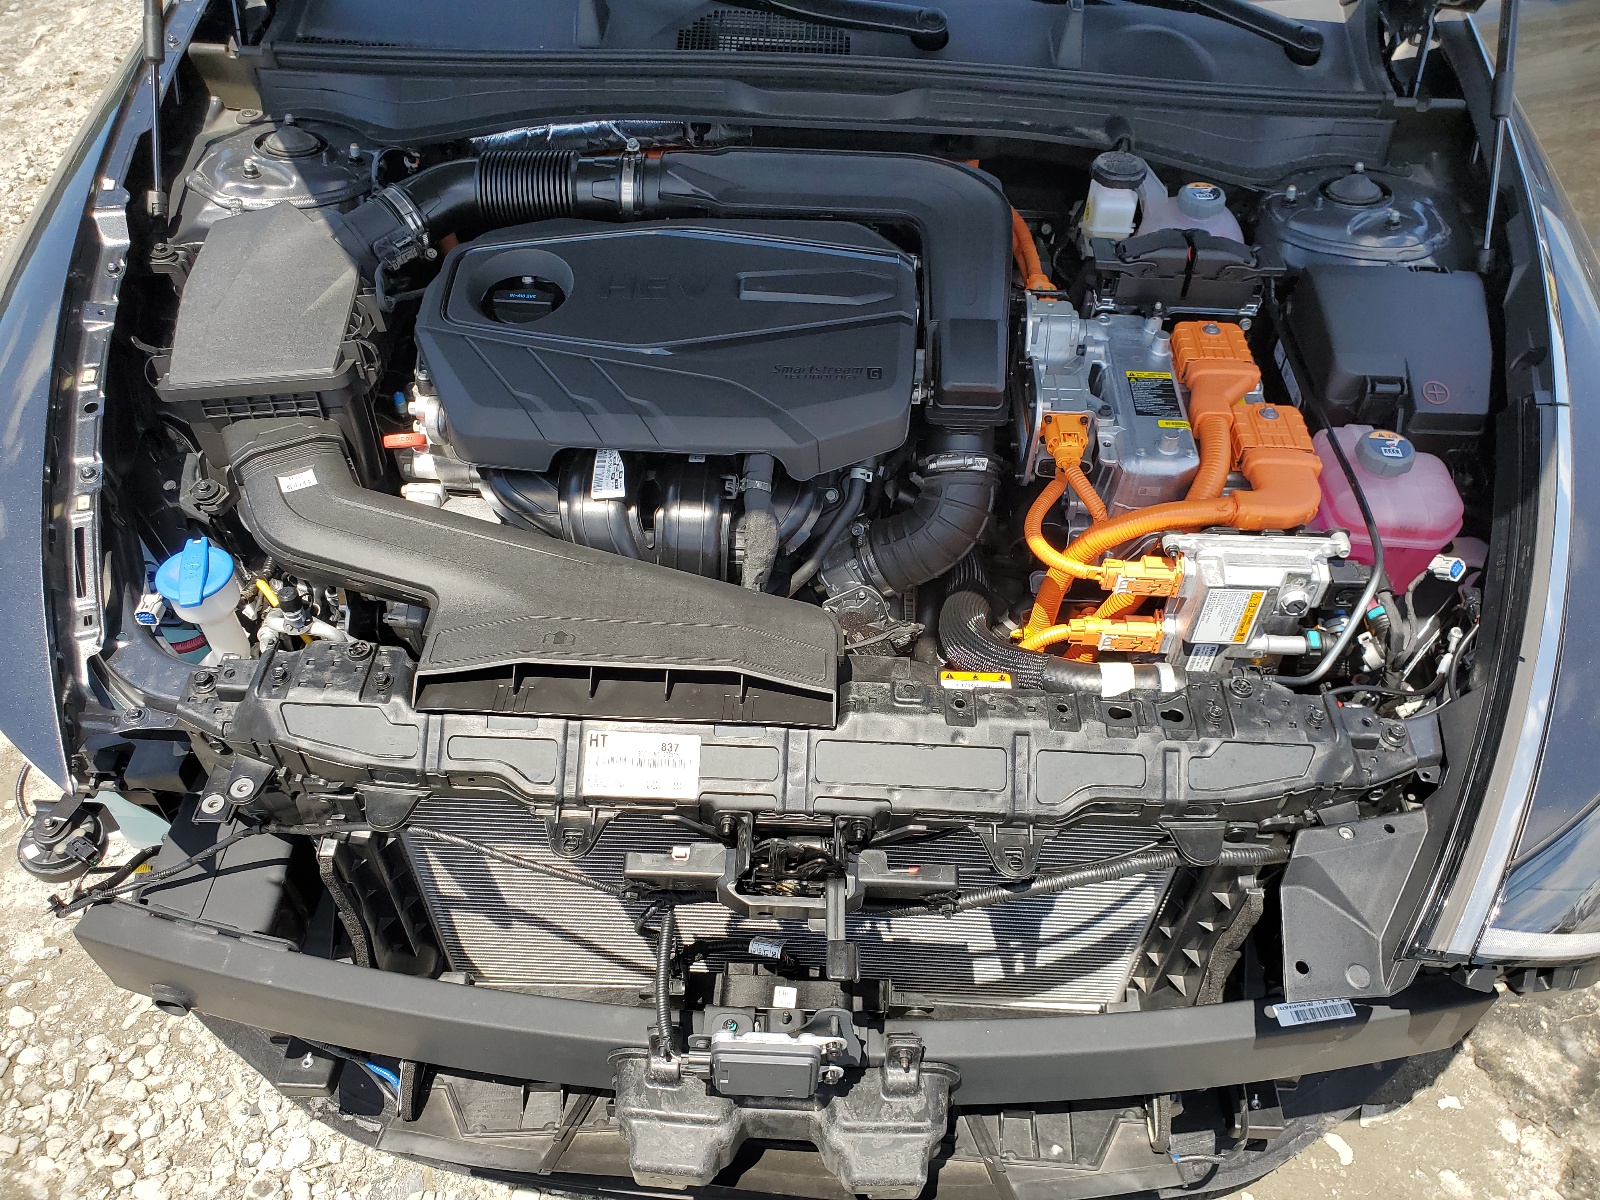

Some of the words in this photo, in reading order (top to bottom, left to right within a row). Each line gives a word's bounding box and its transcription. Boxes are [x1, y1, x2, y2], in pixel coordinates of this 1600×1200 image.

[598, 273, 715, 300] HEV
[773, 364, 864, 375] Smartstream
[869, 368, 880, 379] G
[589, 733, 609, 748] HT
[661, 742, 680, 753] 837
